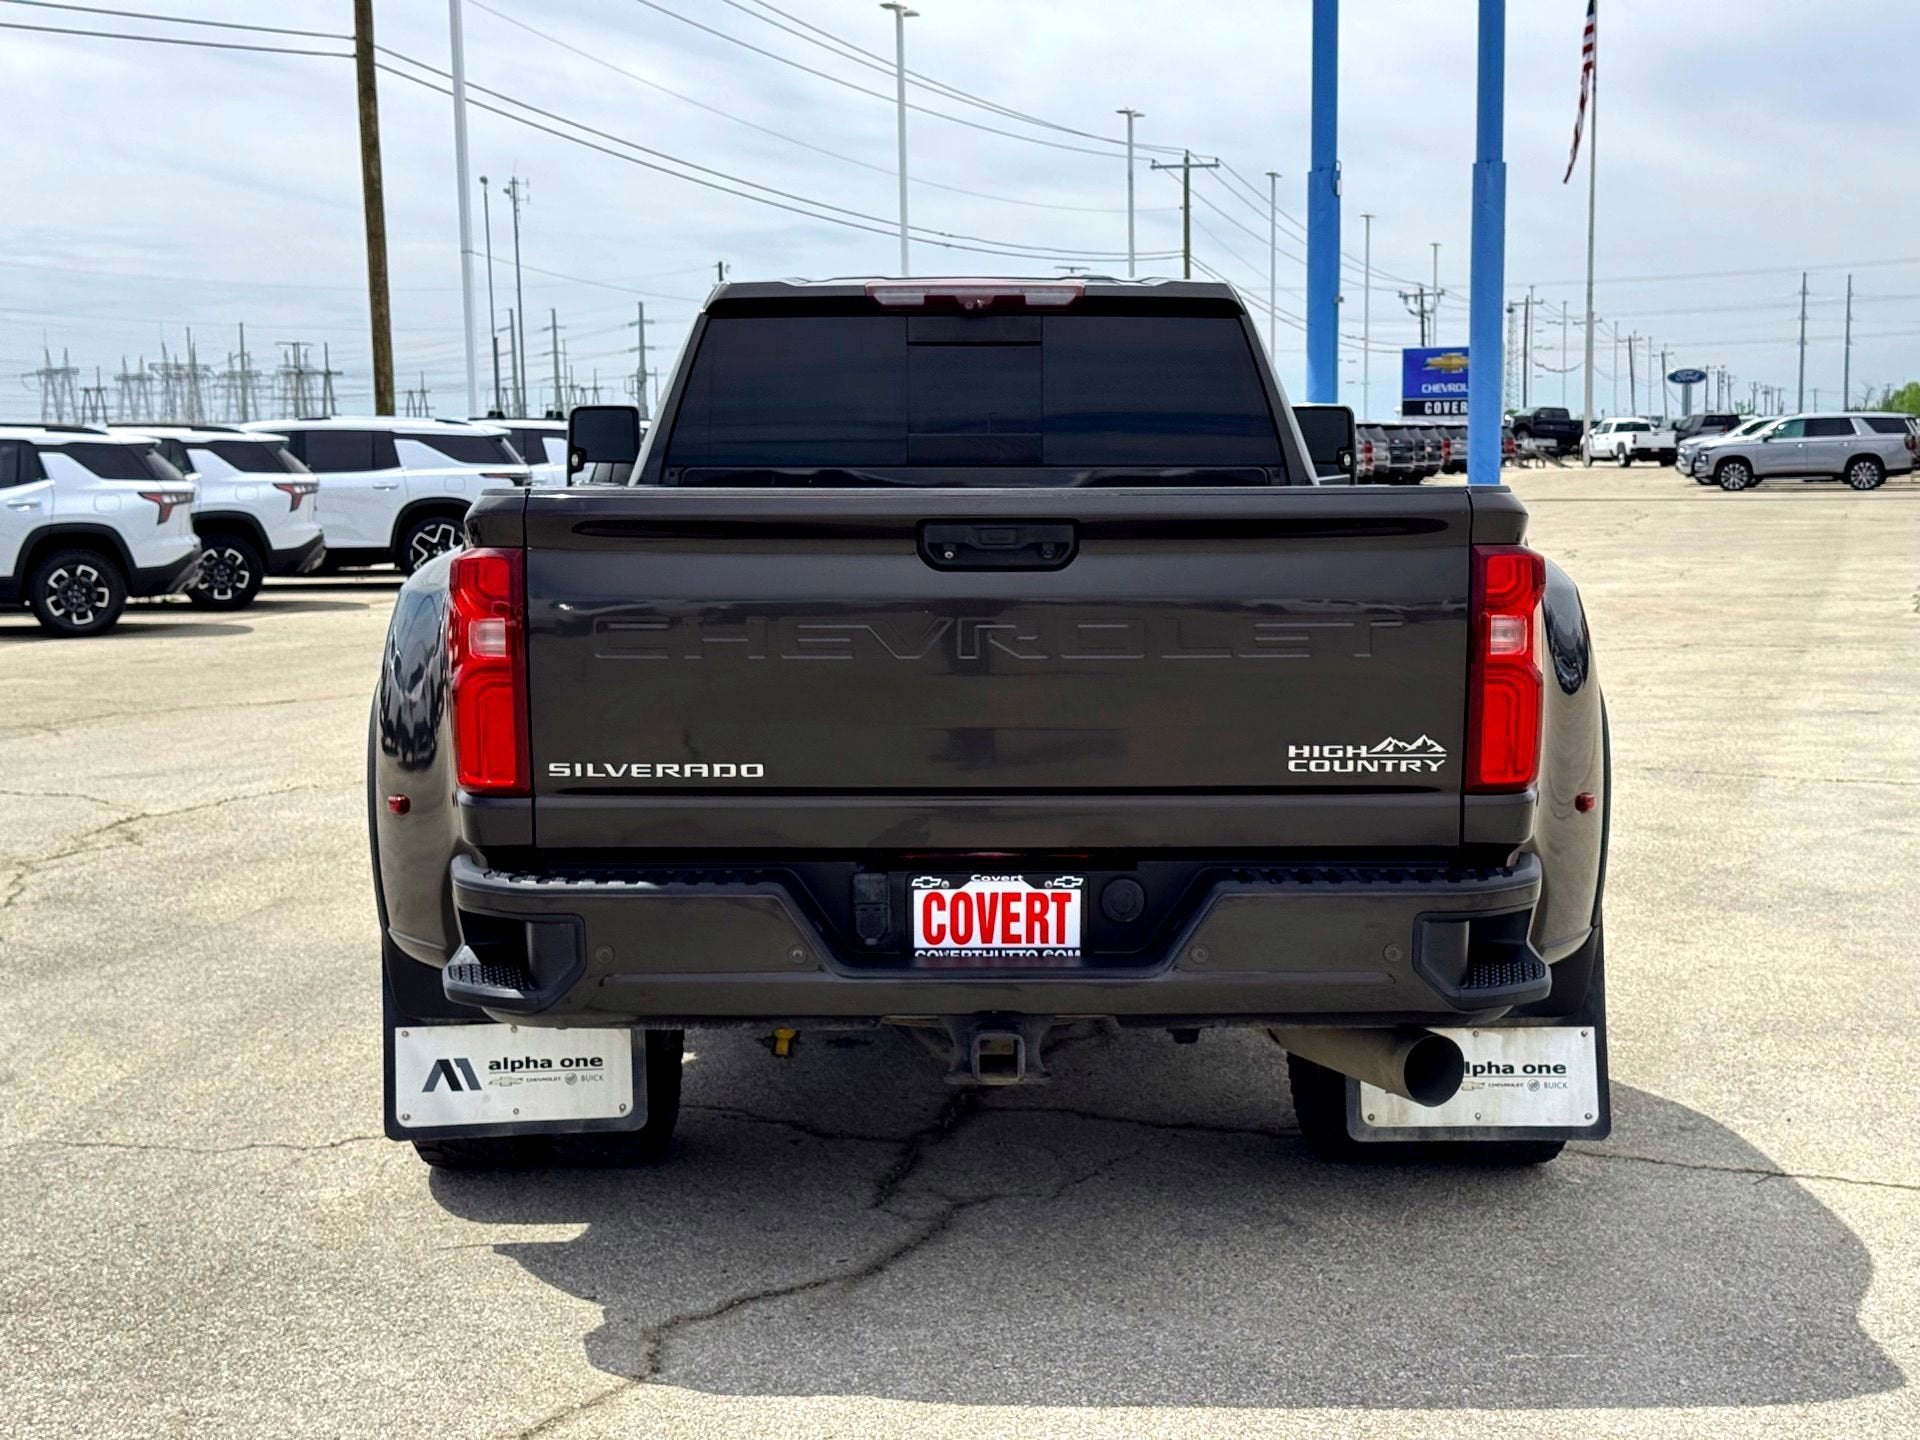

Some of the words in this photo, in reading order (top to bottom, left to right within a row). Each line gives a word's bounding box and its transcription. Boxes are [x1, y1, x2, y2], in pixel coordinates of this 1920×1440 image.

[1421, 383, 1468, 393] CHEVROL
[1424, 401, 1468, 414] COVER
[593, 616, 1403, 660] CHEVROLET
[1288, 745, 1367, 758] HIGH
[548, 762, 765, 778] SILVERADO
[1287, 759, 1446, 773] COUNTRY
[970, 874, 1023, 882] Covert
[922, 891, 1072, 945] COVERT
[914, 949, 1081, 957] COVERTHUTTOCOM
[488, 1056, 552, 1072] alpha
[560, 1056, 603, 1068] one
[1464, 1061, 1515, 1077] lpha
[1522, 1063, 1567, 1075] one
[580, 1073, 604, 1082] BUICK
